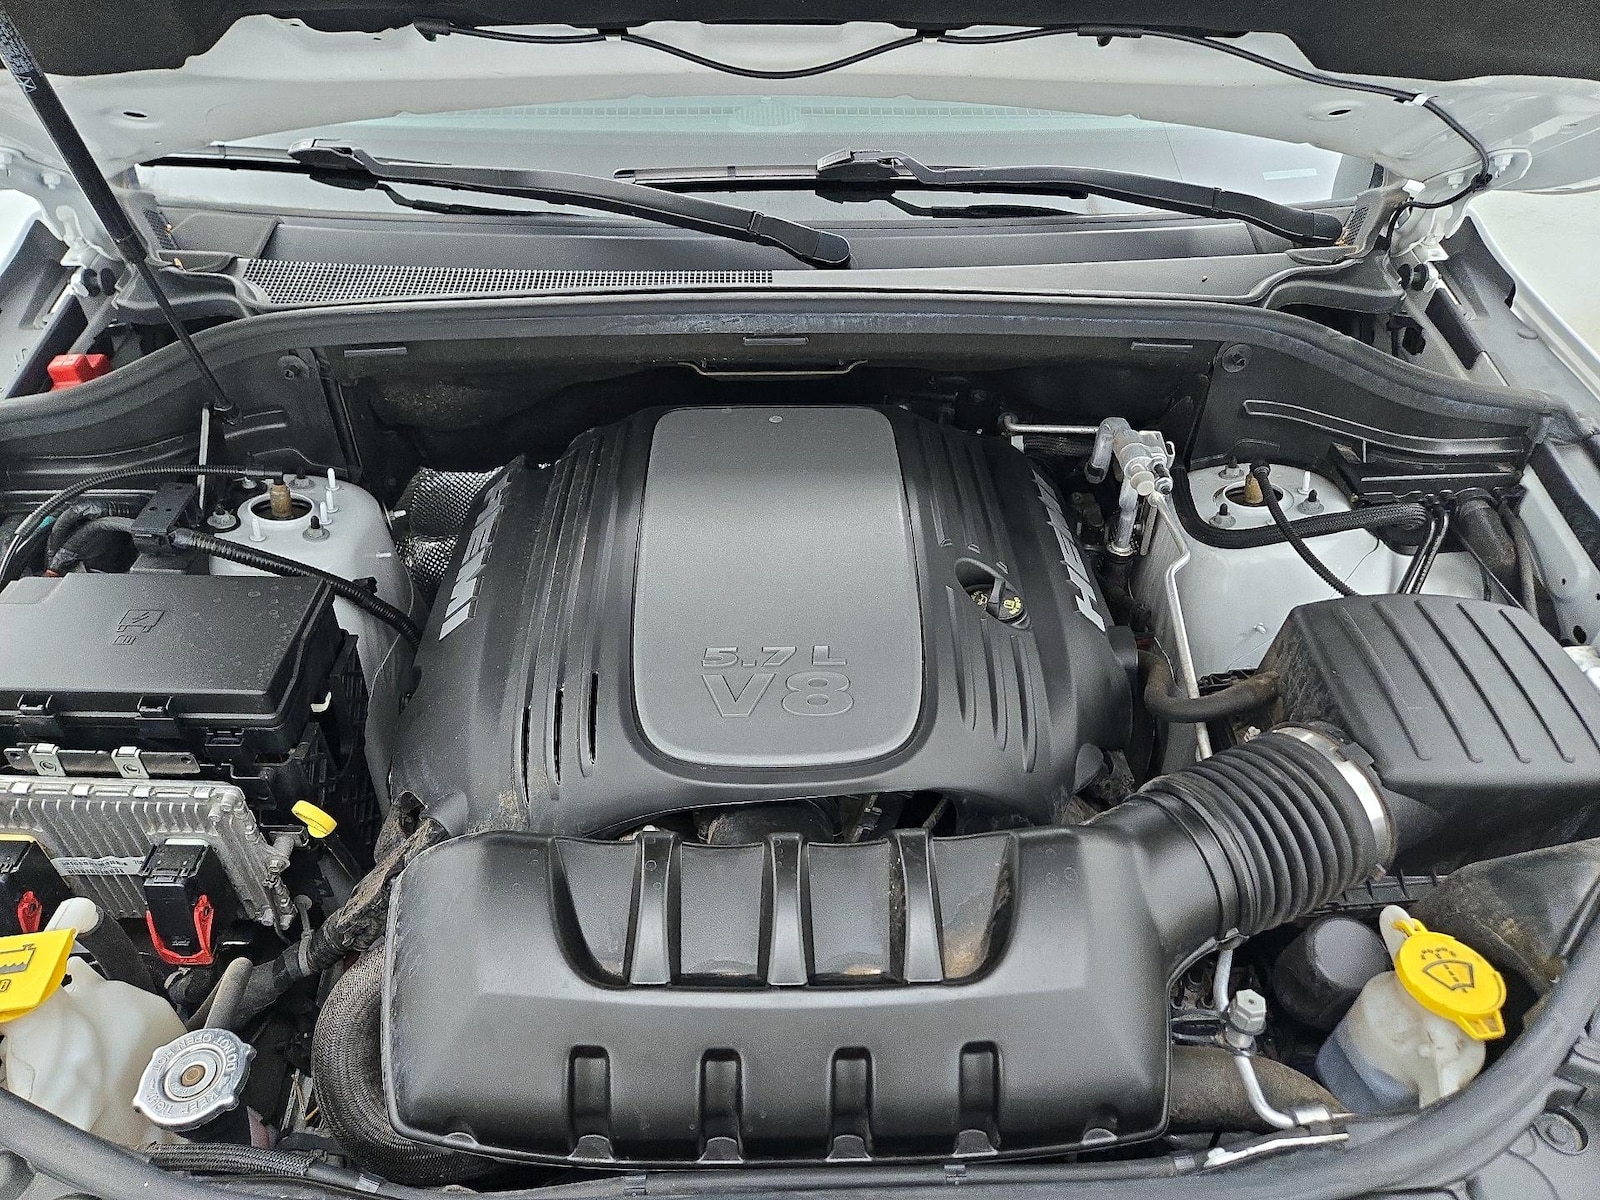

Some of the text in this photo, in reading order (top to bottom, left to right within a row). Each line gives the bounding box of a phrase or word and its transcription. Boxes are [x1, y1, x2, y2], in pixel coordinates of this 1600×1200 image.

[1031, 468, 1106, 633] HEMI
[701, 645, 847, 668] 5.7 L
[701, 671, 854, 718] V8
[178, 1033, 213, 1050] OPEN
